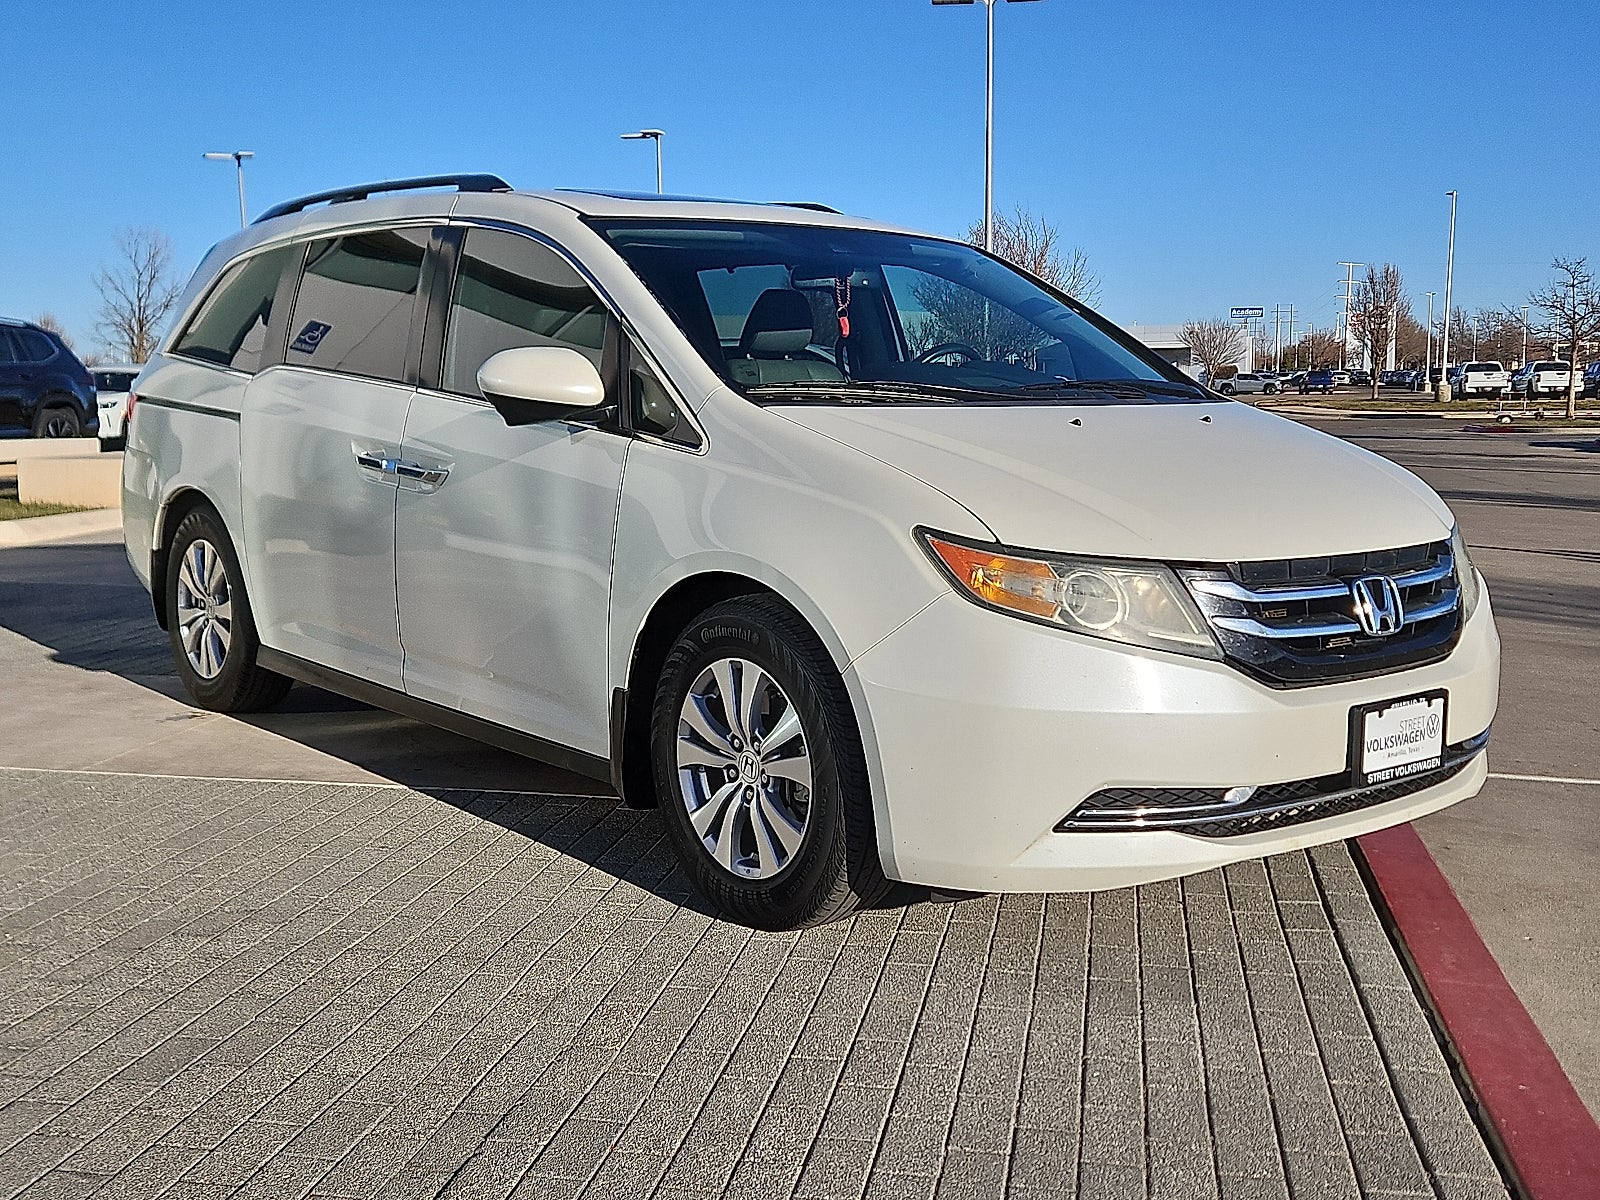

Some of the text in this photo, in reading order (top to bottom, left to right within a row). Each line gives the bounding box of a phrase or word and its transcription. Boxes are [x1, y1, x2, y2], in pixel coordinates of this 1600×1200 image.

[700, 624, 752, 643] Continental
[1399, 715, 1426, 733] STREET
[1366, 729, 1425, 753] VOLKSWAGEN
[1367, 757, 1441, 784] STREET VOLKSWAGEN
